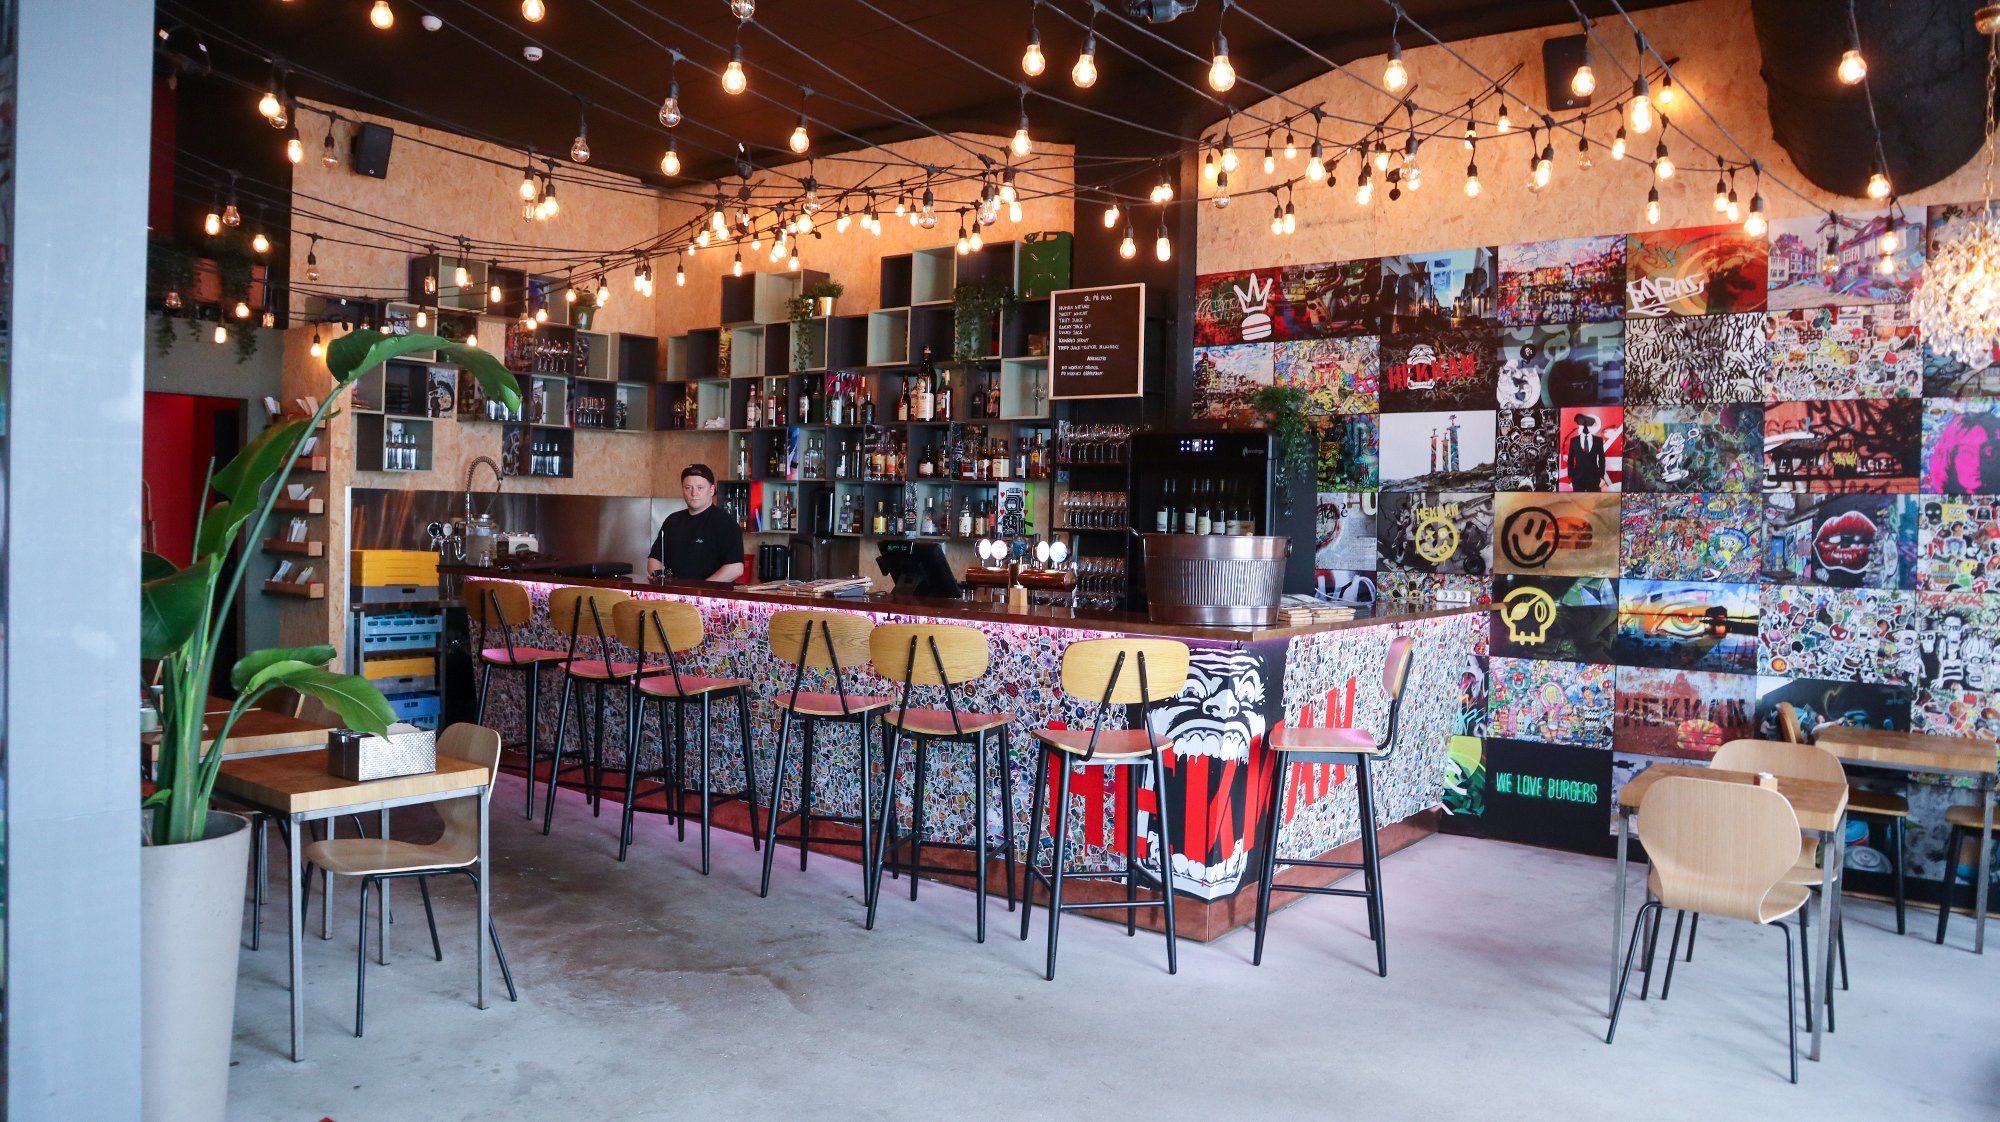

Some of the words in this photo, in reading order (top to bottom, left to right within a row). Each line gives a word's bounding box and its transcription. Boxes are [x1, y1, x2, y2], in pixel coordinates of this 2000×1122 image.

[1496, 771, 1512, 793] WE
[1517, 774, 1543, 797] LOVE
[1548, 778, 1598, 804] BURGERS
